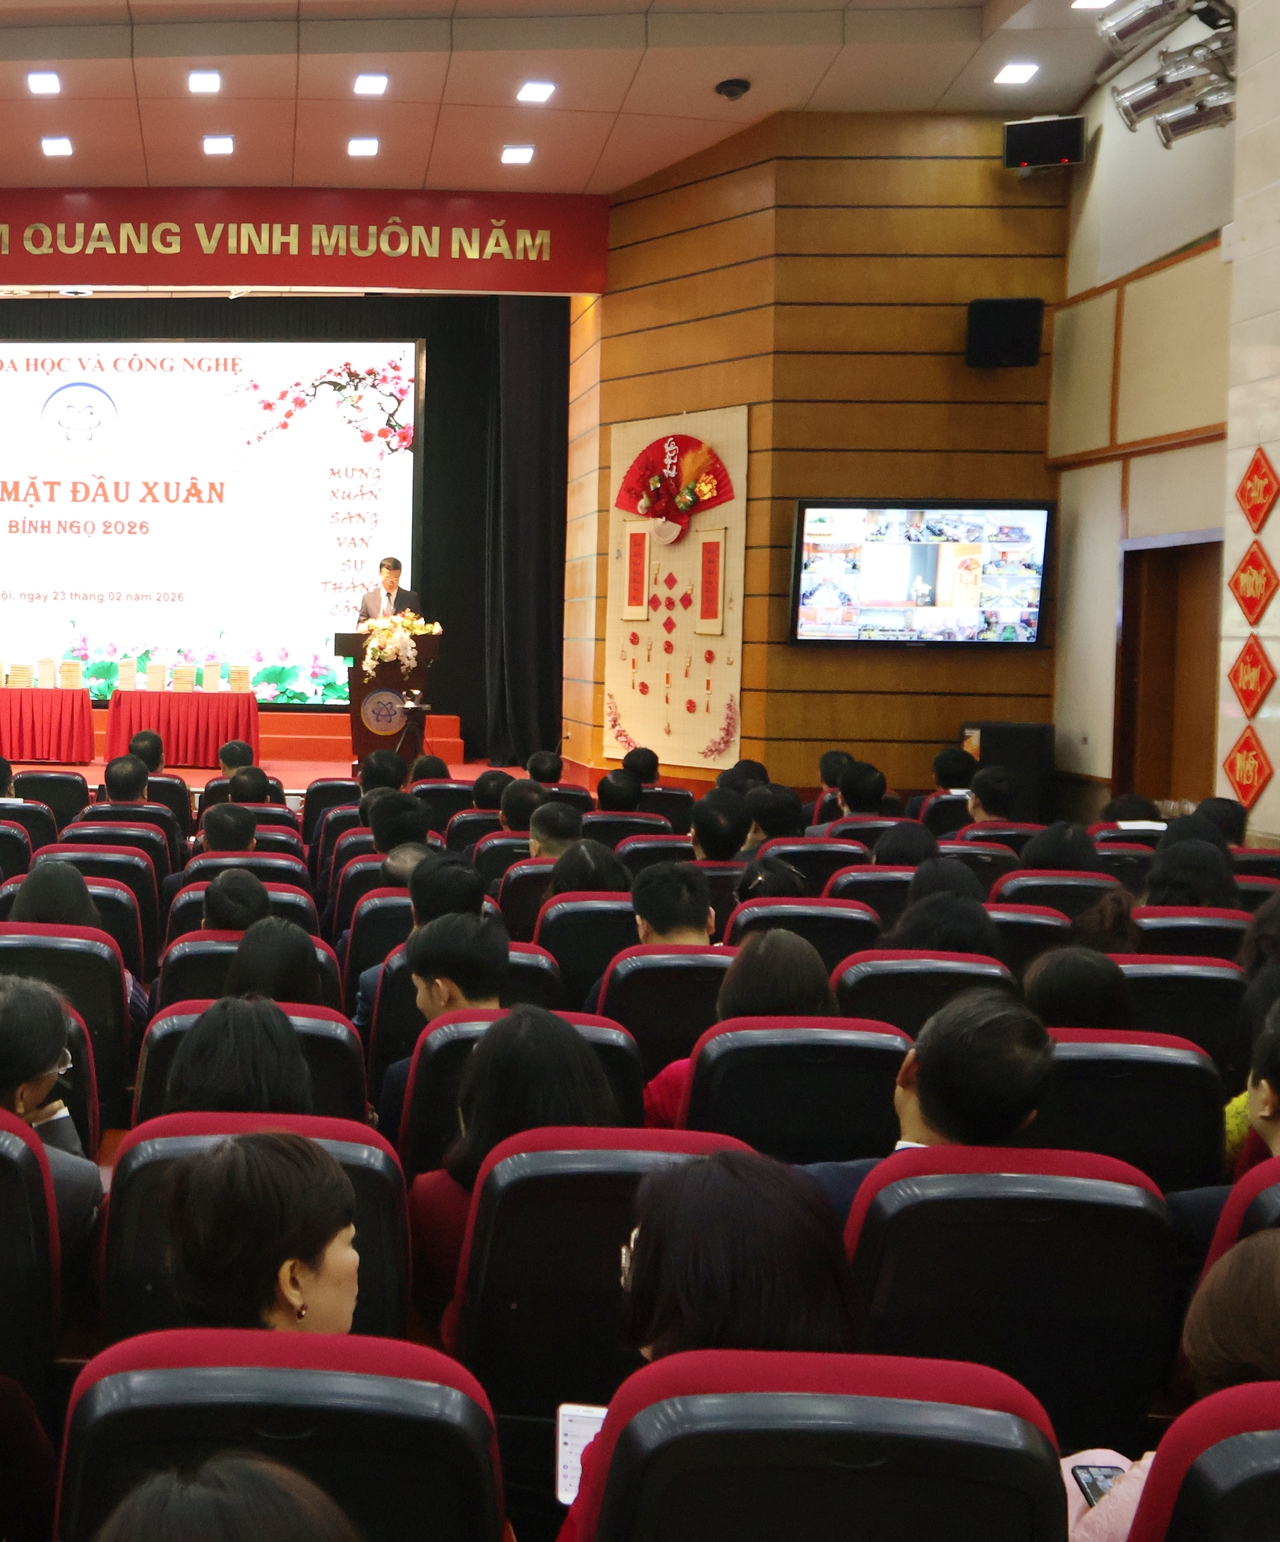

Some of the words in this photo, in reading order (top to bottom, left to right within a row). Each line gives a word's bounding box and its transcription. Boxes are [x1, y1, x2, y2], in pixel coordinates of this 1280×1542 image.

[23, 222, 182, 257] QUANG
[195, 222, 300, 256] VINH
[312, 217, 441, 259] MUÔN
[451, 218, 552, 262] NĂM
[25, 357, 71, 376] HỌC
[78, 353, 106, 373] VÀ
[112, 352, 175, 373] CÔNG
[70, 473, 131, 504] ĐẦU
[138, 475, 226, 504] XUÂN
[7, 516, 52, 535] BÍNH
[56, 520, 96, 538] NGỌ
[102, 520, 150, 536] 2026
[329, 509, 379, 531] SANG
[20, 592, 49, 603] ngày
[53, 591, 67, 601] 23
[70, 592, 105, 604] tháng
[108, 592, 122, 602] 02
[156, 592, 185, 603] 2026
